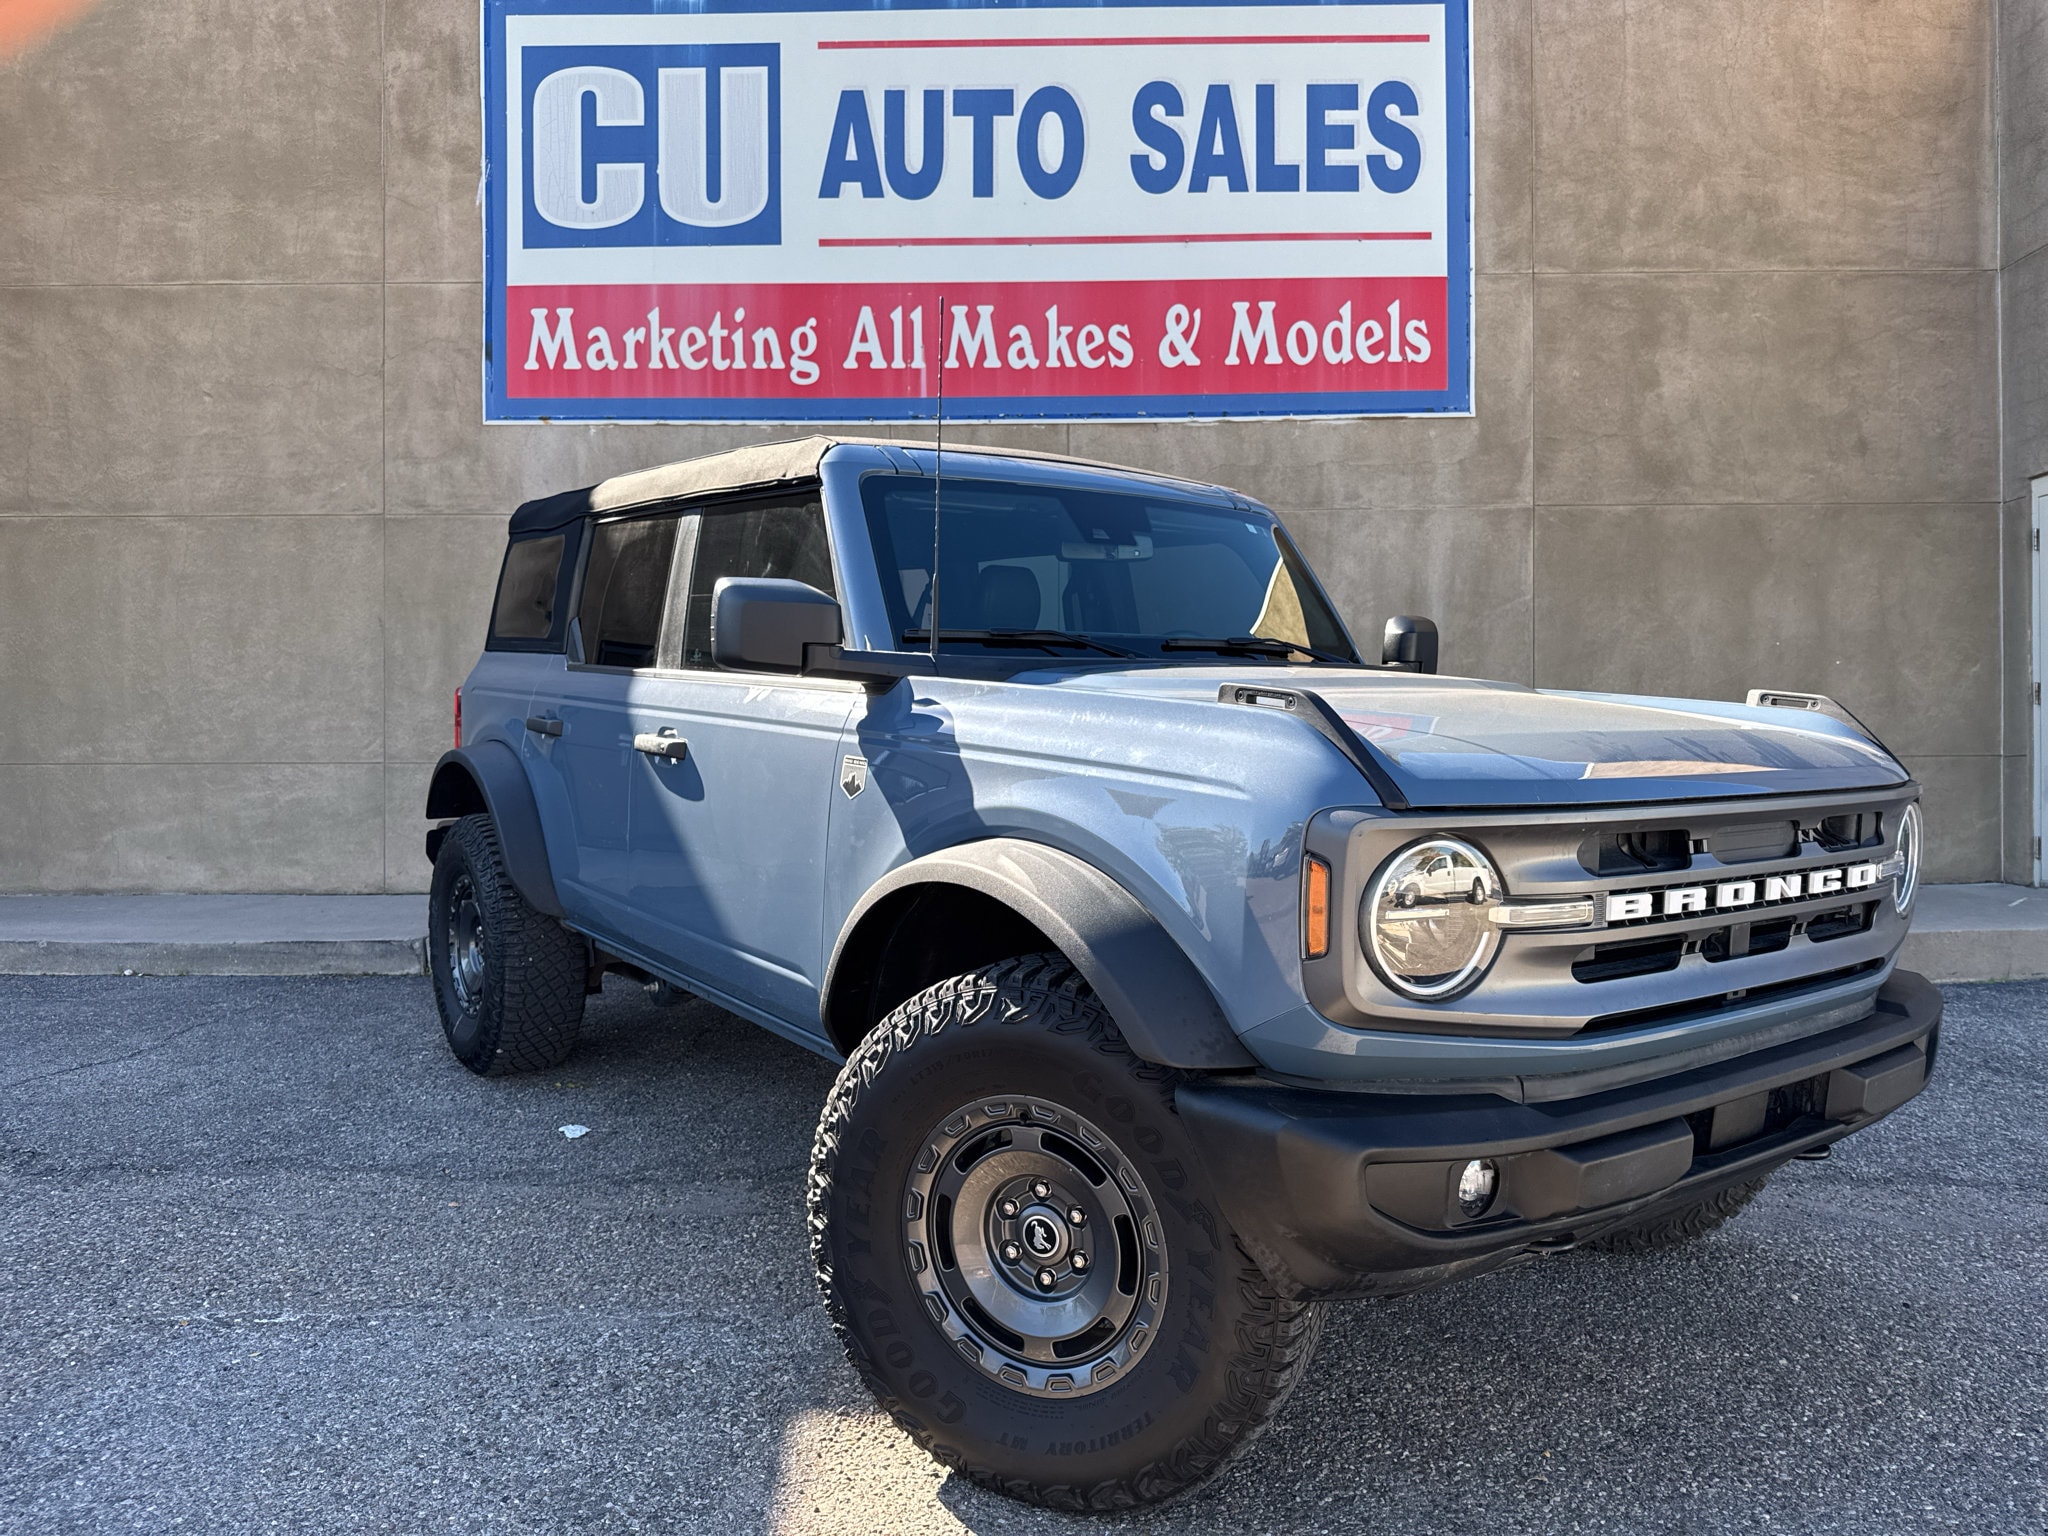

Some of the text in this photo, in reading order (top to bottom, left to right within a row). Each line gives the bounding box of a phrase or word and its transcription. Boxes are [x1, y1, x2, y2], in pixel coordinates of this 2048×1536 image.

[533, 65, 769, 229] CU
[818, 79, 1423, 201] AUTO SALES
[524, 299, 1432, 385] Marketing All Makes & Models
[1606, 863, 1877, 922] BRONCO
[1044, 1410, 1155, 1456] TERRITORY
